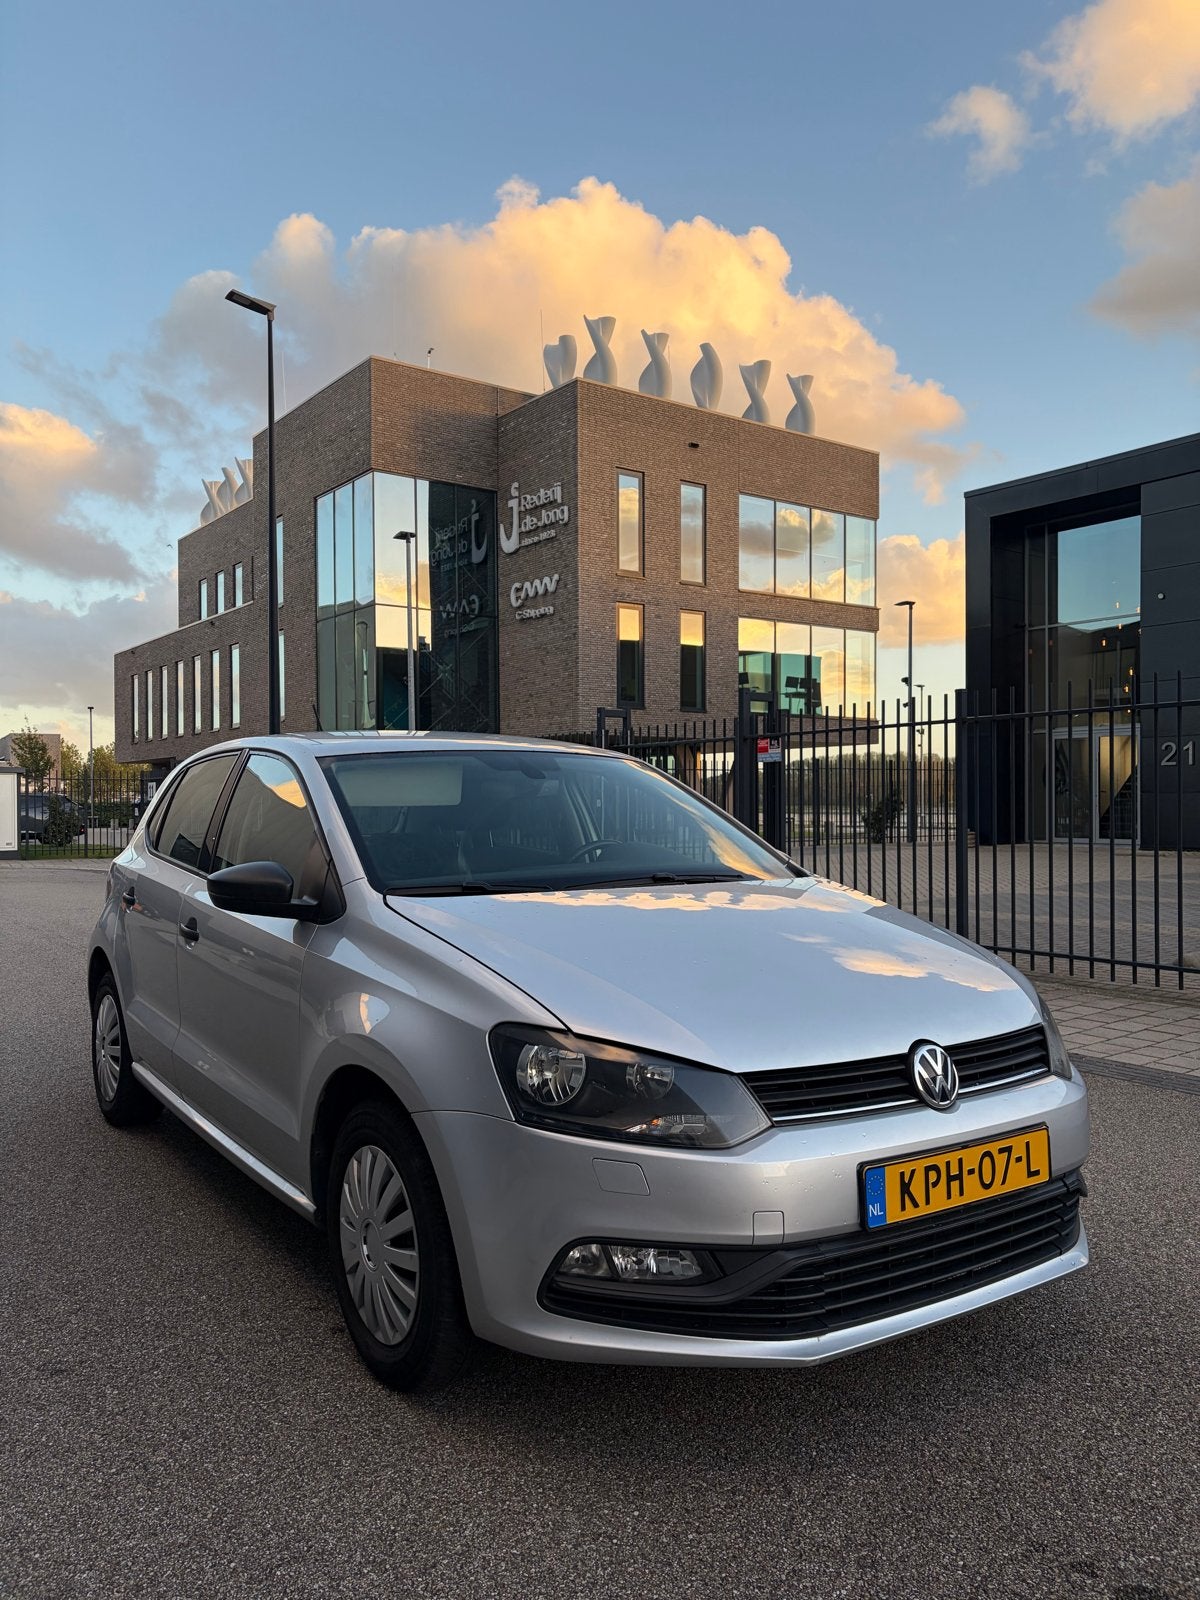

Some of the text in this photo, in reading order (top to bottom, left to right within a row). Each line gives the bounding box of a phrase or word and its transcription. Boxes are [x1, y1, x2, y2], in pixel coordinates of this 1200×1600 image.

[520, 482, 562, 511] Rederij
[521, 505, 569, 532] de Jong
[1160, 740, 1193, 766] 21
[900, 1141, 1041, 1212] KPH-07-L
[868, 1203, 884, 1218] NL
